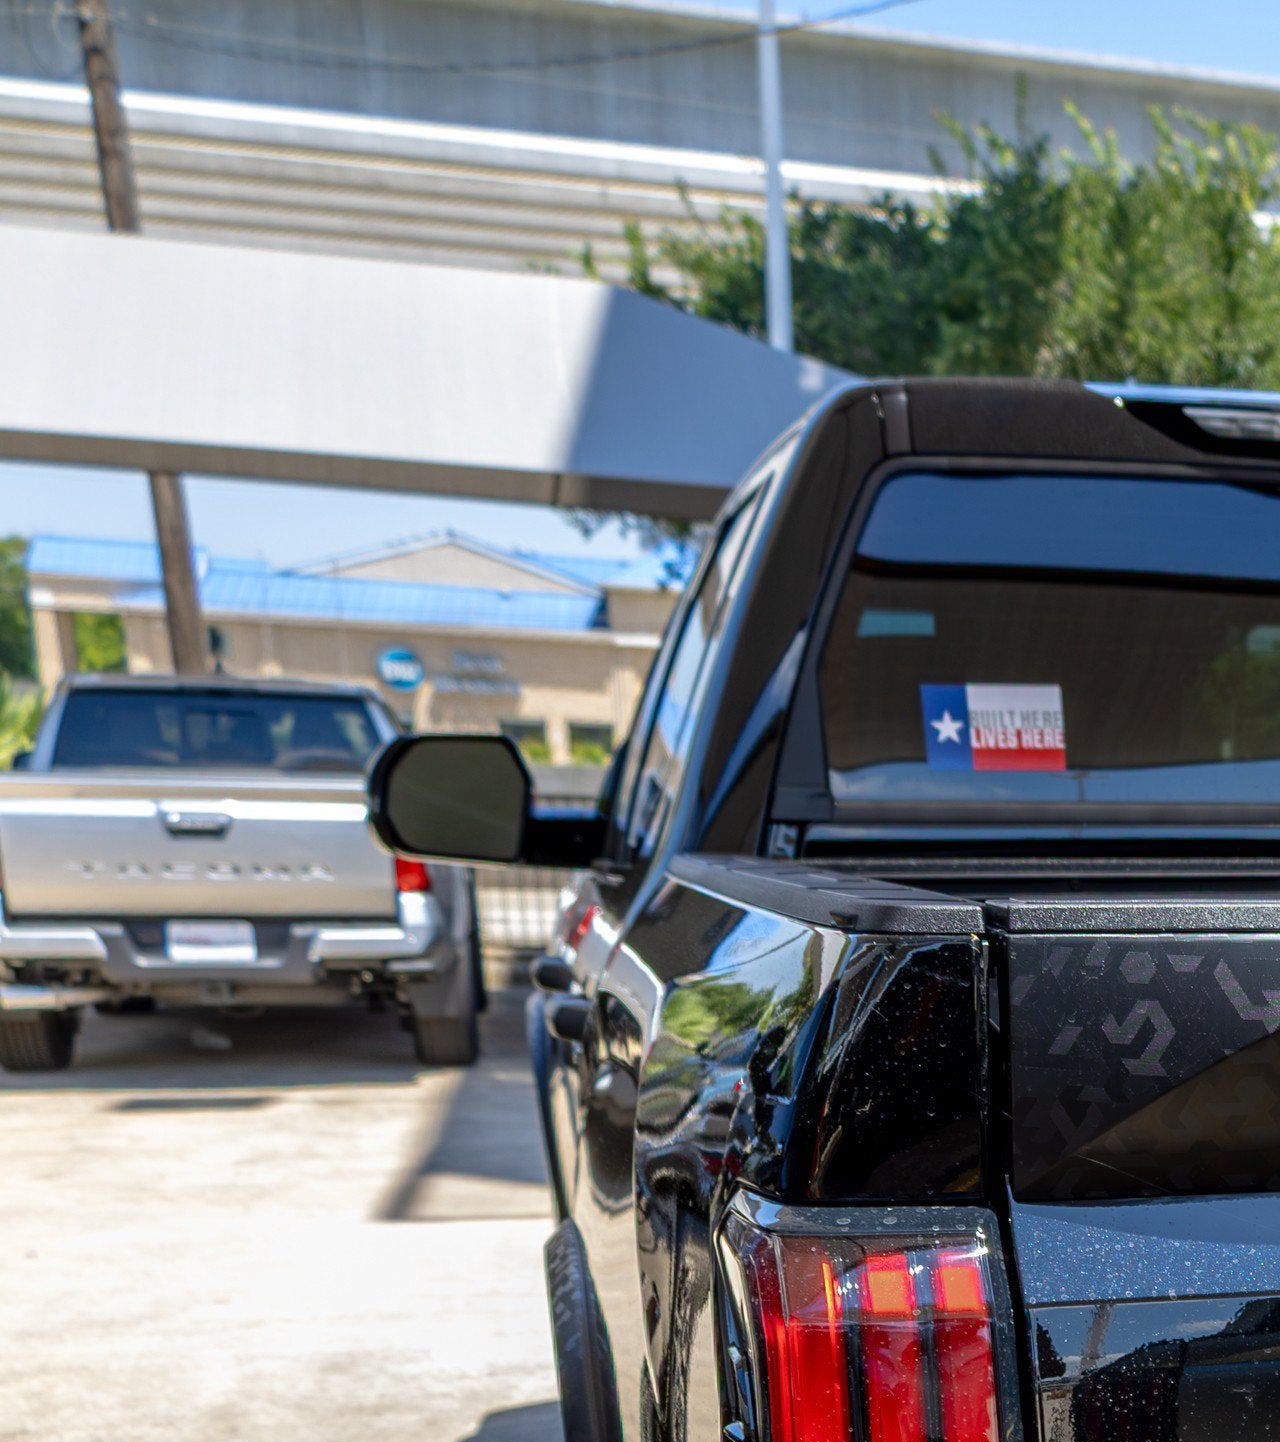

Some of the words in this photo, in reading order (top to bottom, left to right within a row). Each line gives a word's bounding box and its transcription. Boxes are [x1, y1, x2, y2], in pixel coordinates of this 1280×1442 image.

[970, 710, 1016, 729] BUILT
[1020, 709, 1064, 729] HERE
[971, 728, 1018, 750] LIVES
[1021, 728, 1066, 750] HERE
[66, 860, 335, 881] TACOMA
